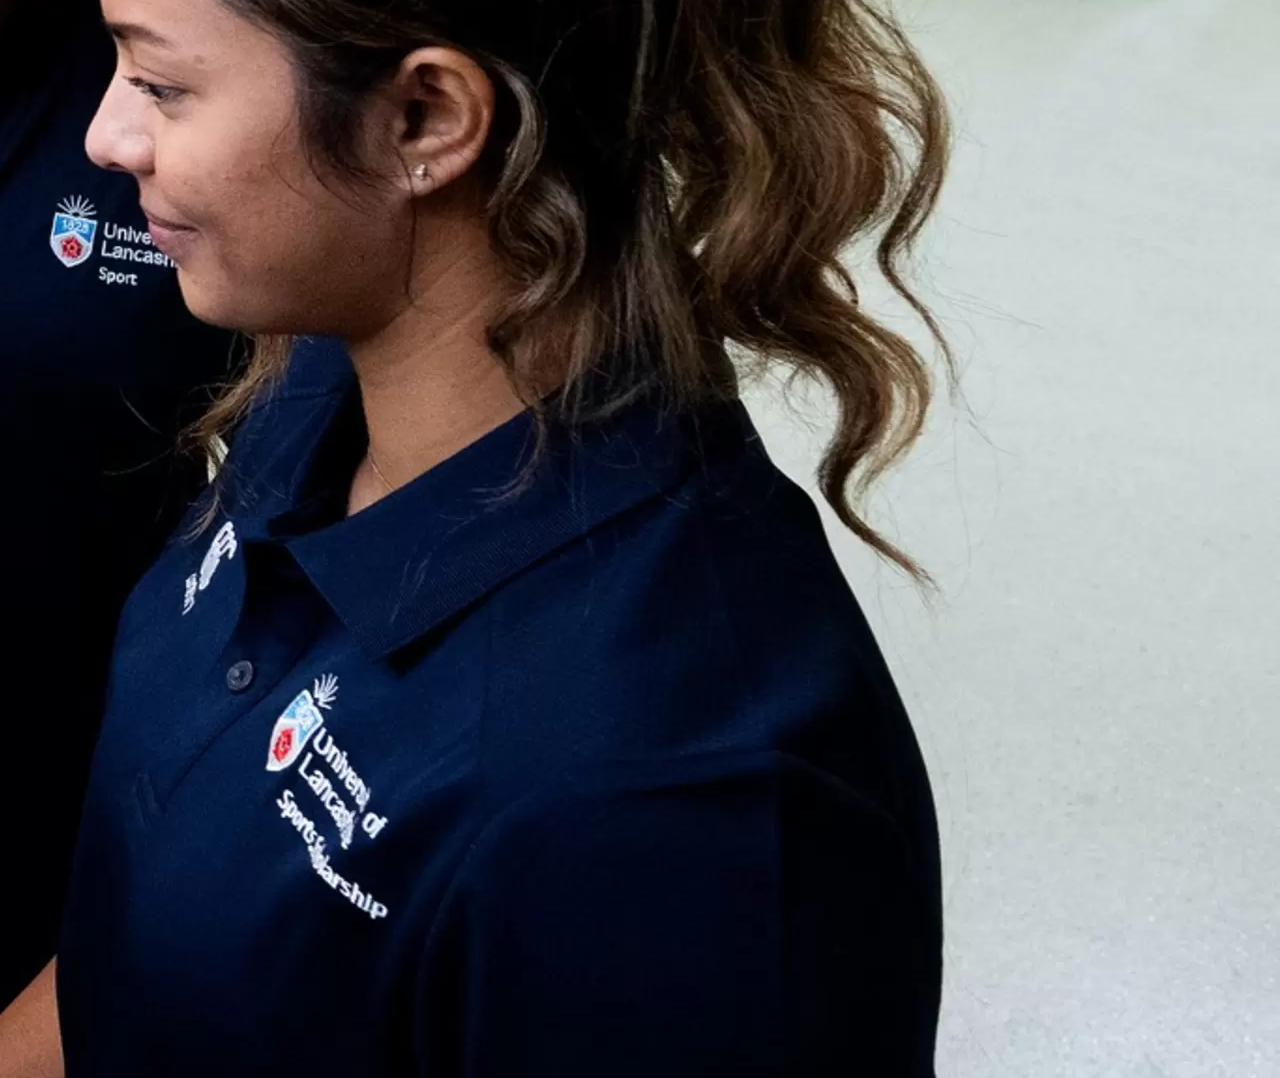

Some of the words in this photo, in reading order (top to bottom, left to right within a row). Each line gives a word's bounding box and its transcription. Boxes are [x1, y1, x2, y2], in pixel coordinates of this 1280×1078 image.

[98, 266, 139, 286] Sport
[103, 221, 155, 246] Unive
[298, 752, 357, 850] Lanca
[313, 727, 371, 813] Univer
[362, 812, 389, 840] of
[276, 789, 318, 844] Sports
[307, 836, 389, 920] Slarship
